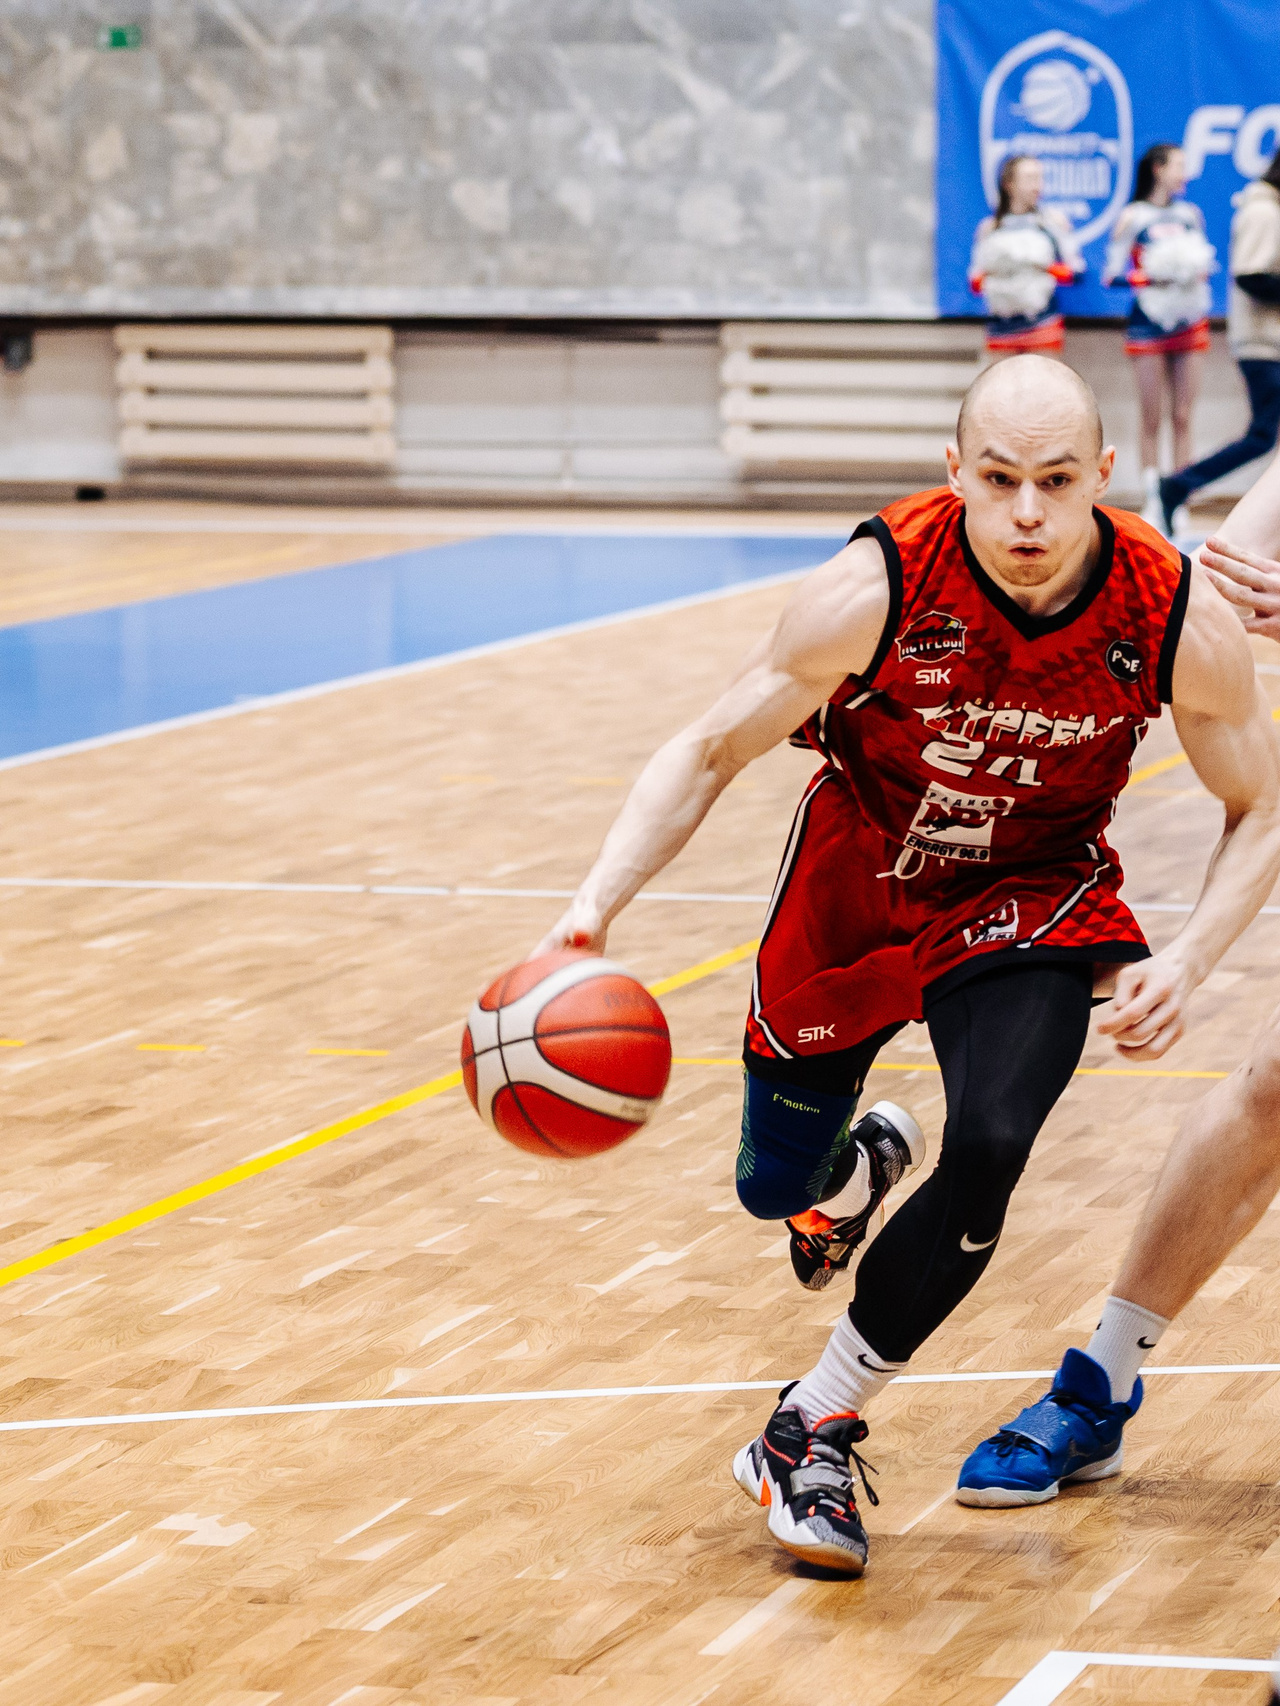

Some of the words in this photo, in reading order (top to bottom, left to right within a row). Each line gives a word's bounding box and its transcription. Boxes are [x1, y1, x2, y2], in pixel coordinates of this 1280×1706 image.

[915, 668, 952, 685] STK
[928, 791, 989, 807] РАДИО
[905, 835, 957, 858] ENERGY
[797, 1023, 836, 1044] STK
